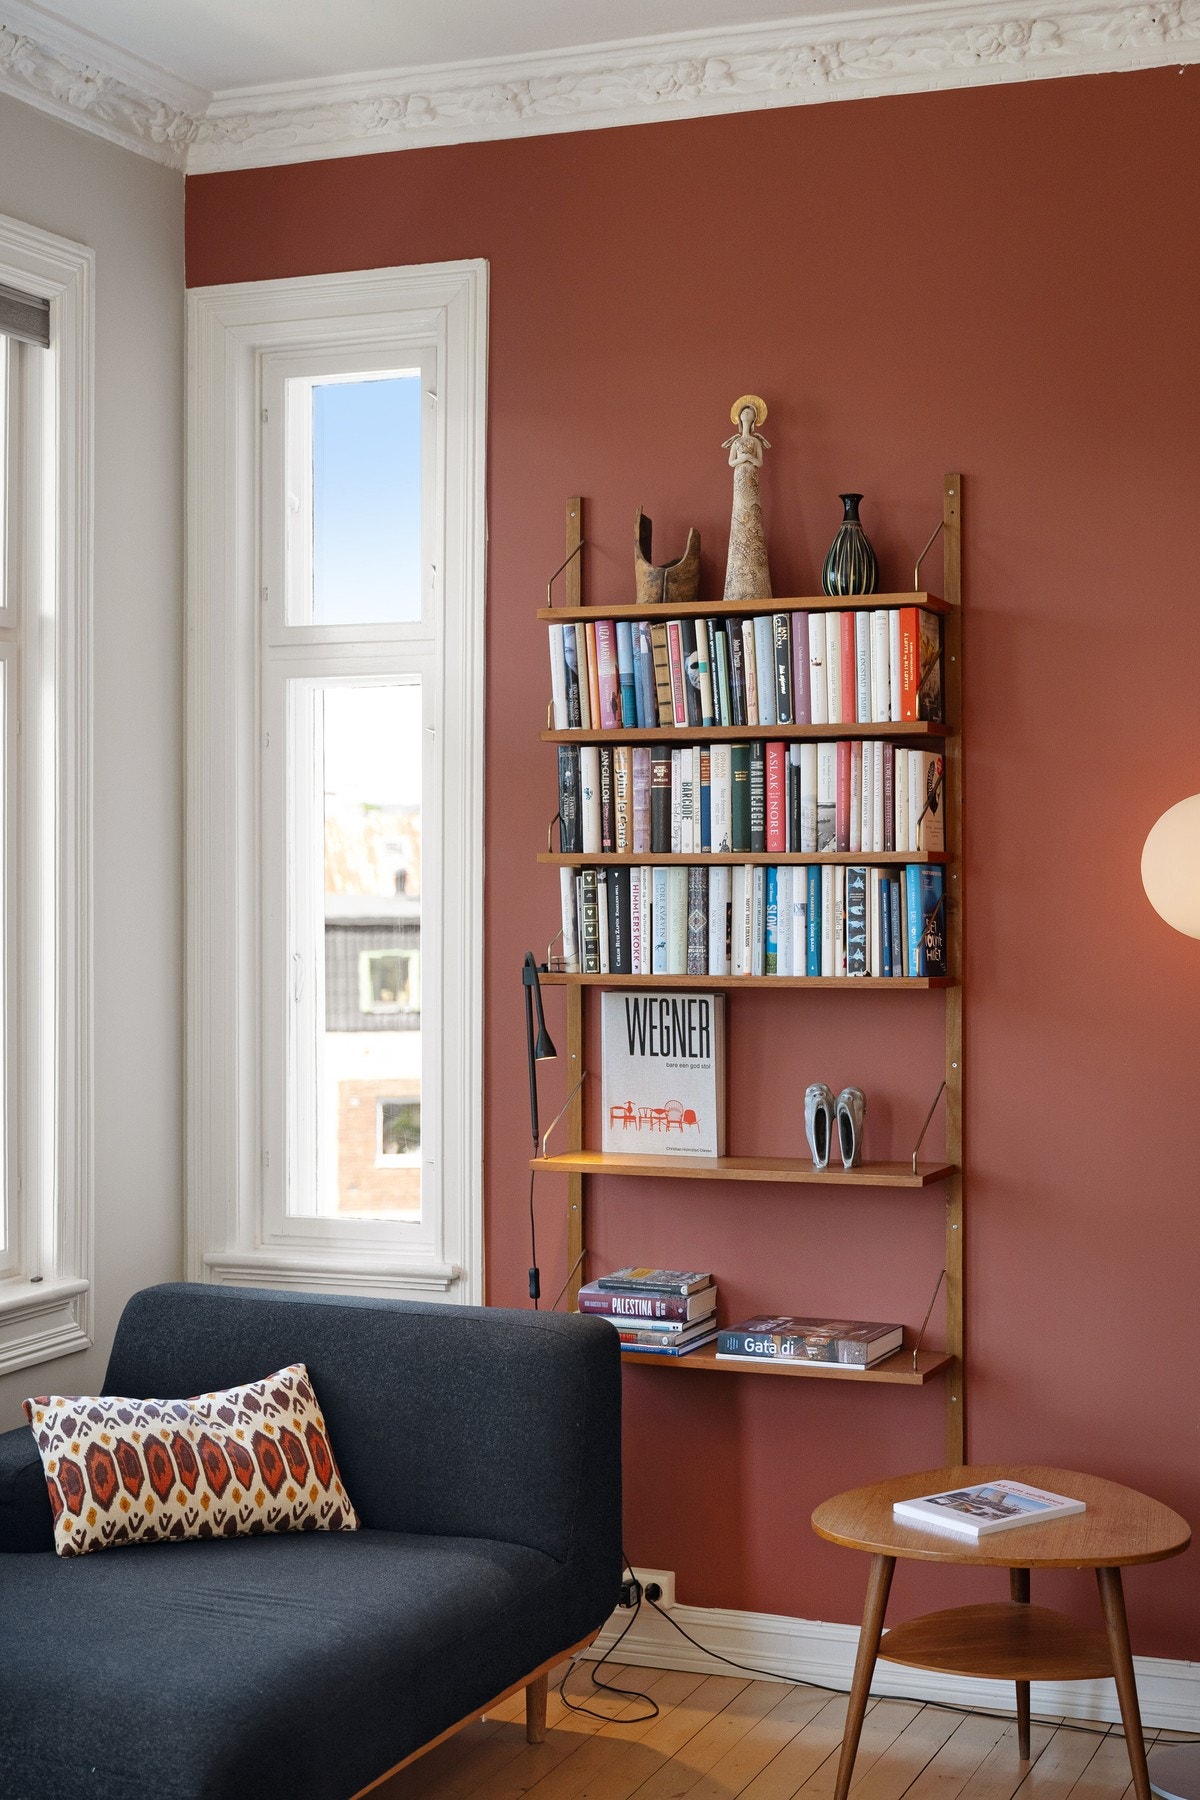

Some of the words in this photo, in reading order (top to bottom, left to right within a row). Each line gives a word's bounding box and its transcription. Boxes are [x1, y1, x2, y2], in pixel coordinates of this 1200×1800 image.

[599, 641, 611, 678] MARKLUND
[733, 639, 741, 651] Johan
[601, 750, 609, 765] JAN
[769, 751, 778, 789] ASLAK
[602, 767, 610, 803] GUILLOU
[615, 769, 627, 797] john
[751, 761, 764, 832] MARINEJEGER
[618, 800, 627, 812] le
[682, 782, 692, 820] BARCODE
[617, 815, 629, 848] Carré
[770, 801, 779, 835] NORE
[632, 884, 640, 933] HIMMLERS
[766, 904, 777, 930] SLOW
[625, 997, 710, 1058] WEGNER
[611, 1297, 652, 1316] PALESTINA
[744, 1337, 777, 1354] Gata
[781, 1340, 794, 1355] di
